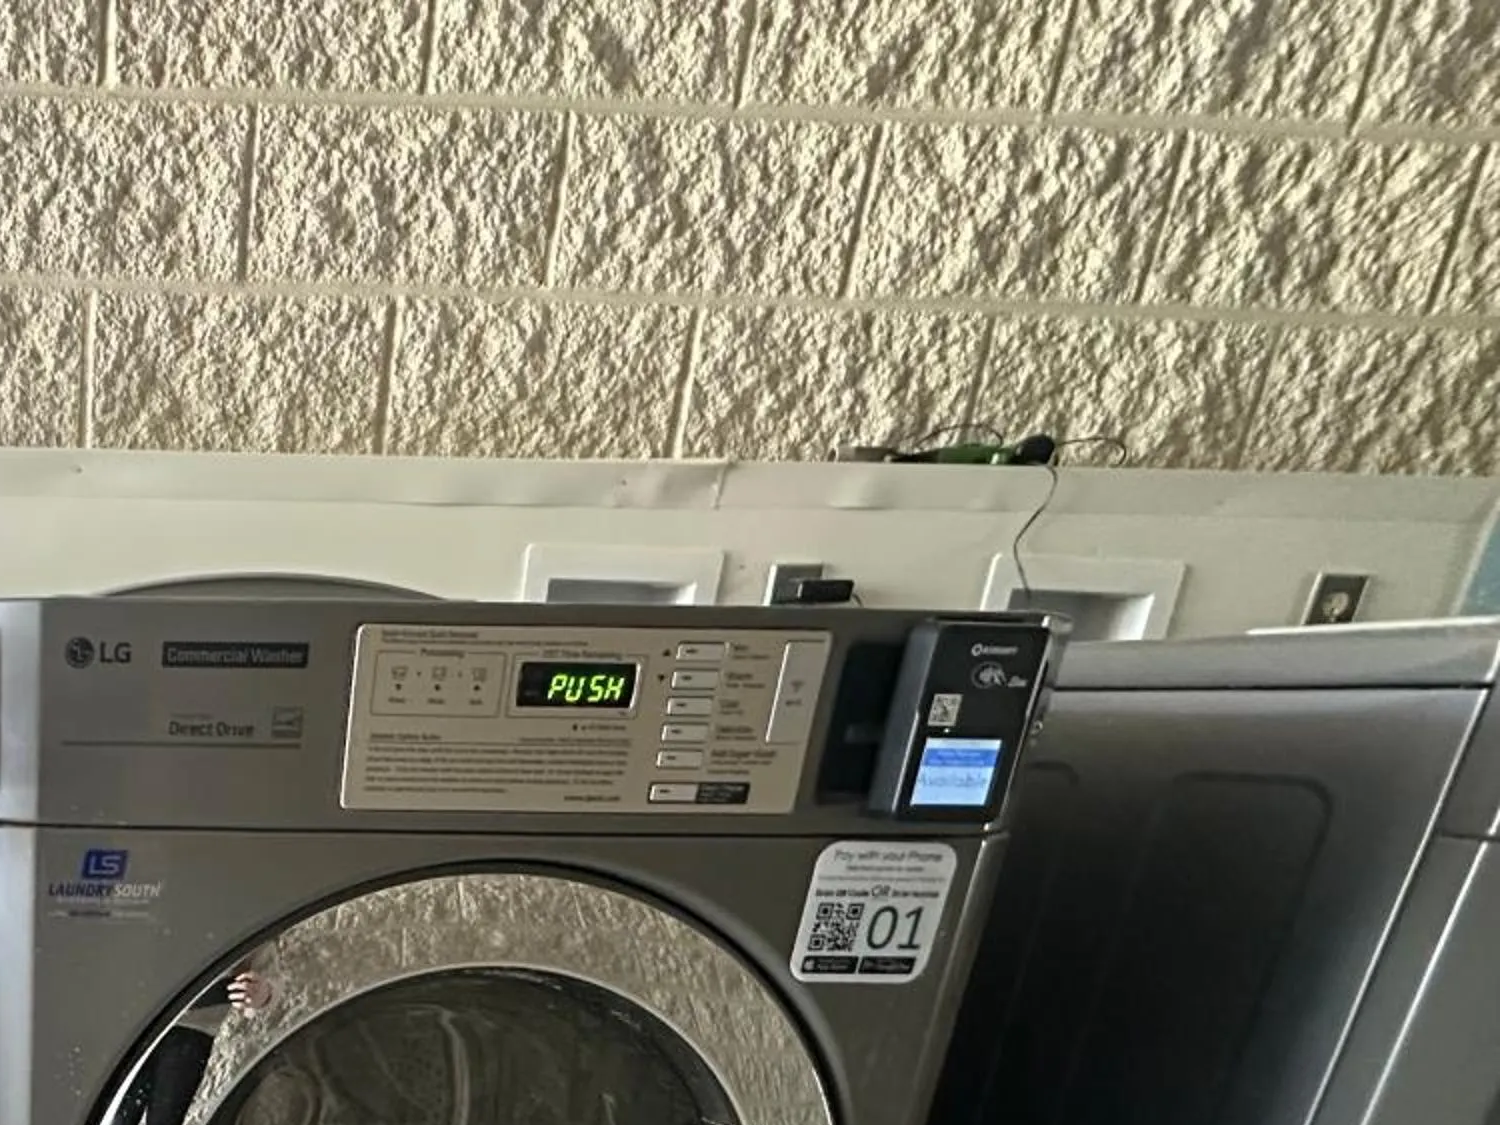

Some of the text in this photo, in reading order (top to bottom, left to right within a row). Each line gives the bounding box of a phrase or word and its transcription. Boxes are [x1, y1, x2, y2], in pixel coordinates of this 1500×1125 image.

[100, 642, 132, 663] LG
[167, 647, 248, 663] Commercial
[547, 674, 626, 703] PUSH
[168, 721, 255, 737] Direct Drive
[866, 905, 925, 950] 01
